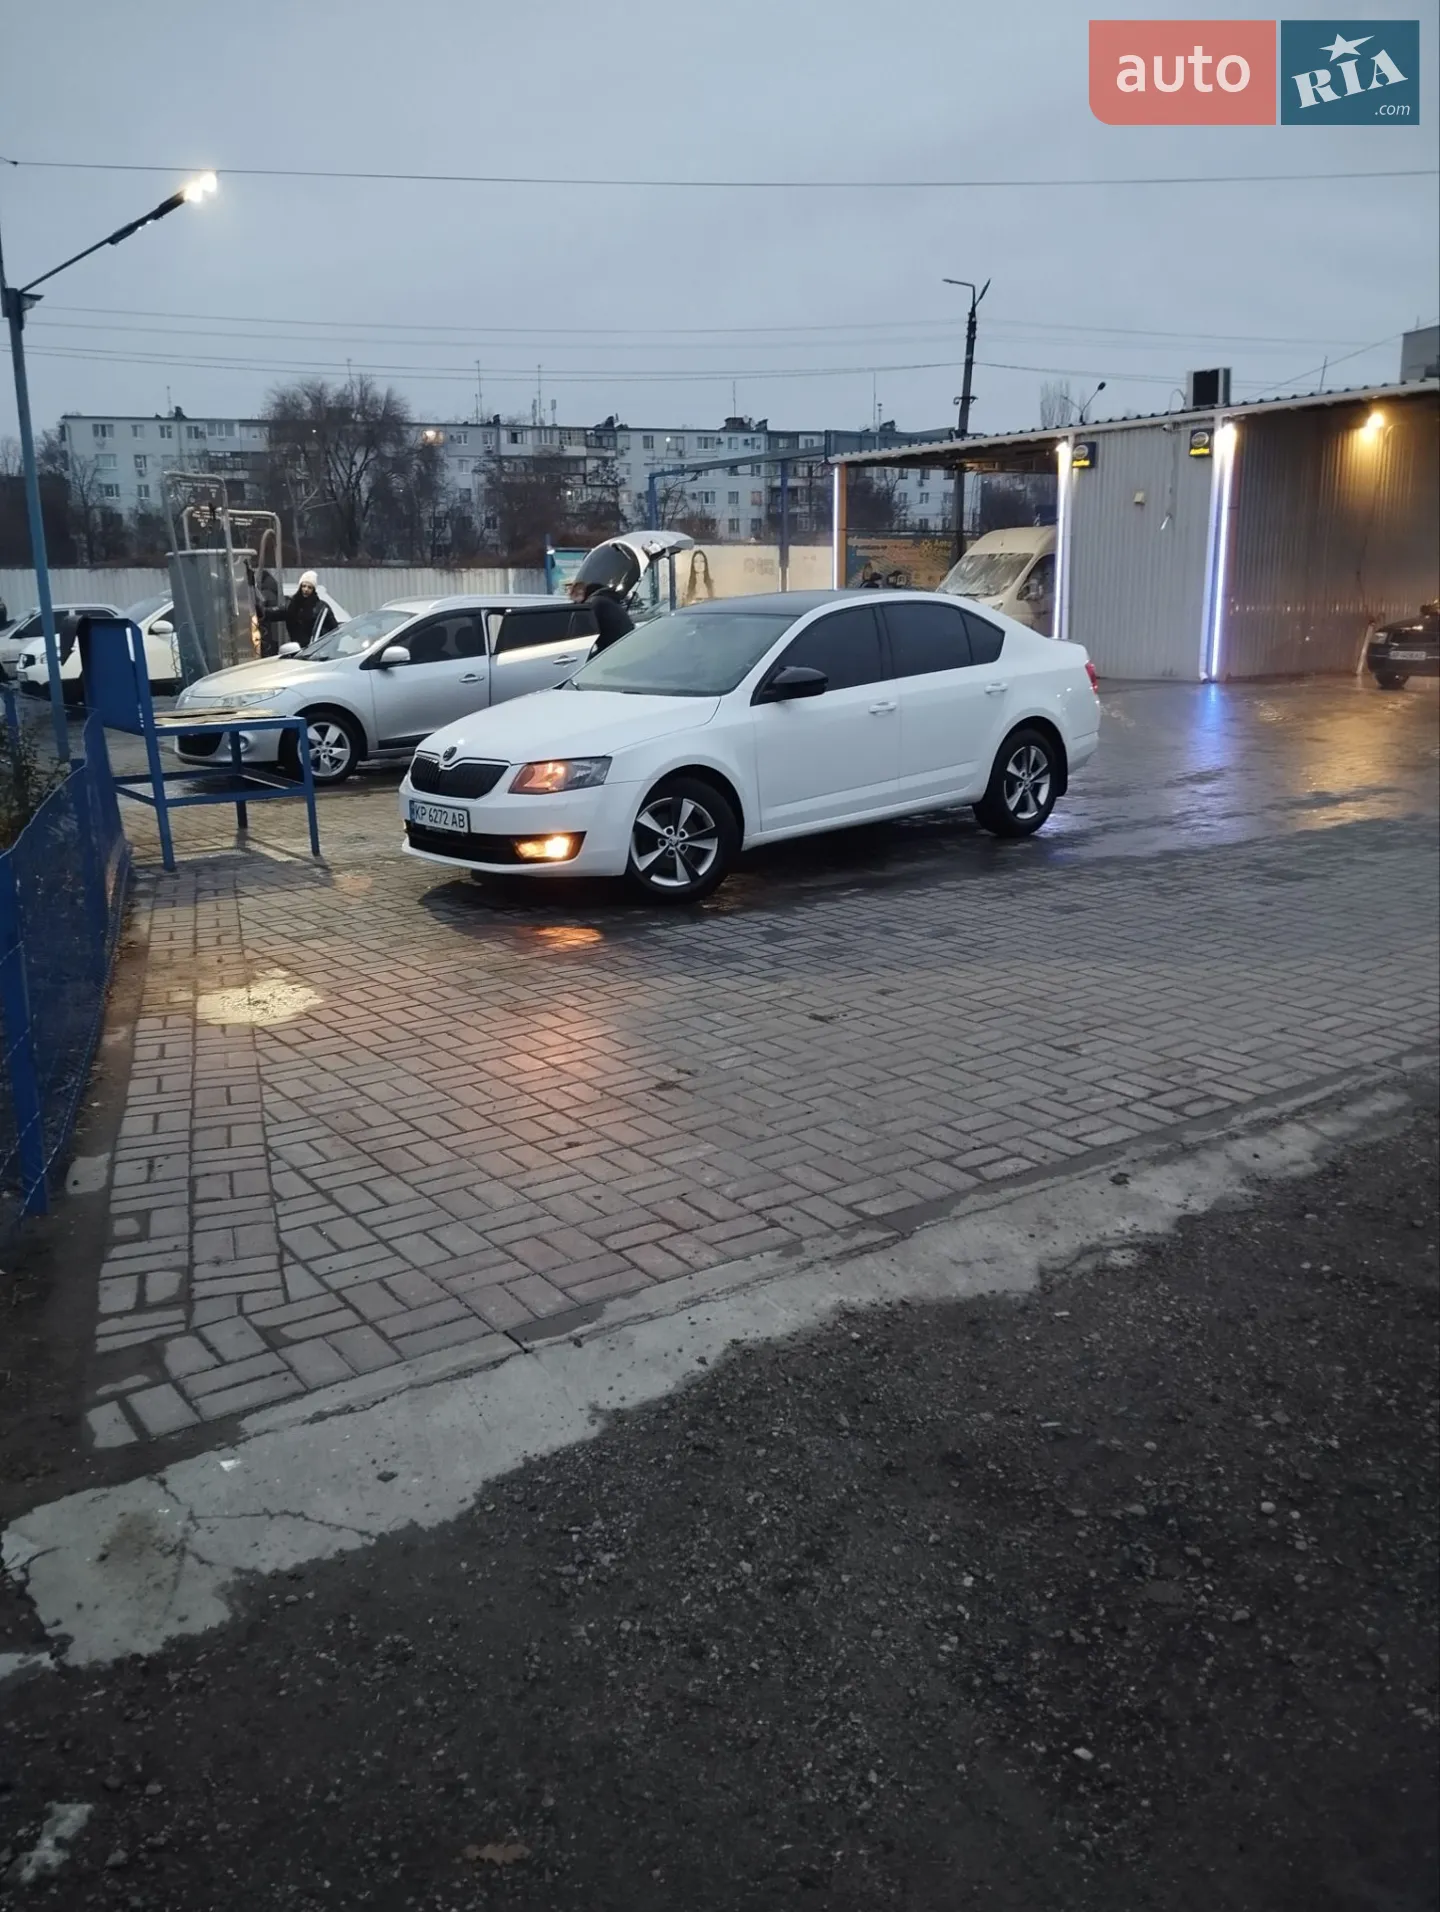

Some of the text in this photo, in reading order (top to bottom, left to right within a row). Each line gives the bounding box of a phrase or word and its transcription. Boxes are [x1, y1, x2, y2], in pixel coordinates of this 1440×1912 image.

[415, 805, 465, 828] KP 6272 AB
